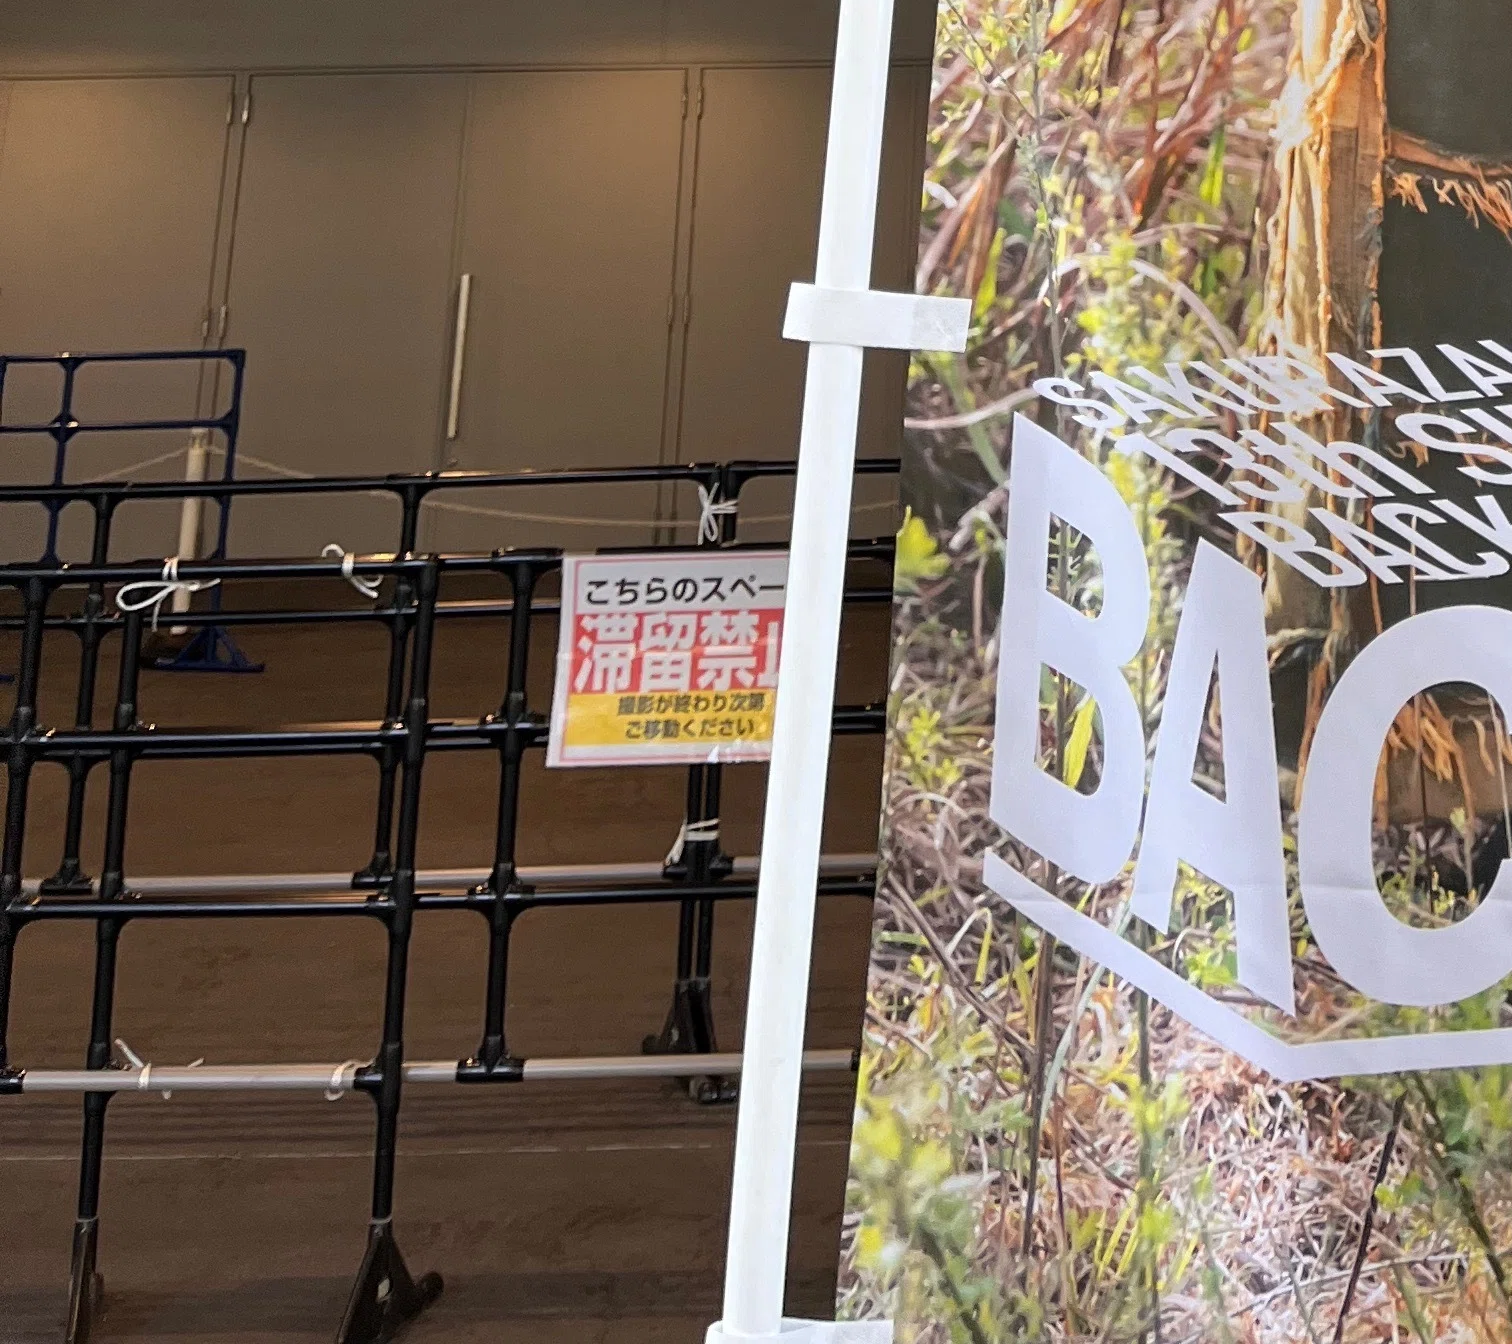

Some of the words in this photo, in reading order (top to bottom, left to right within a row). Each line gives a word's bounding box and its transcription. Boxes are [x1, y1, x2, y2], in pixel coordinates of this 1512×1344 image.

[1114, 419, 1434, 507] 13th
[625, 717, 755, 739] ご移動ください
